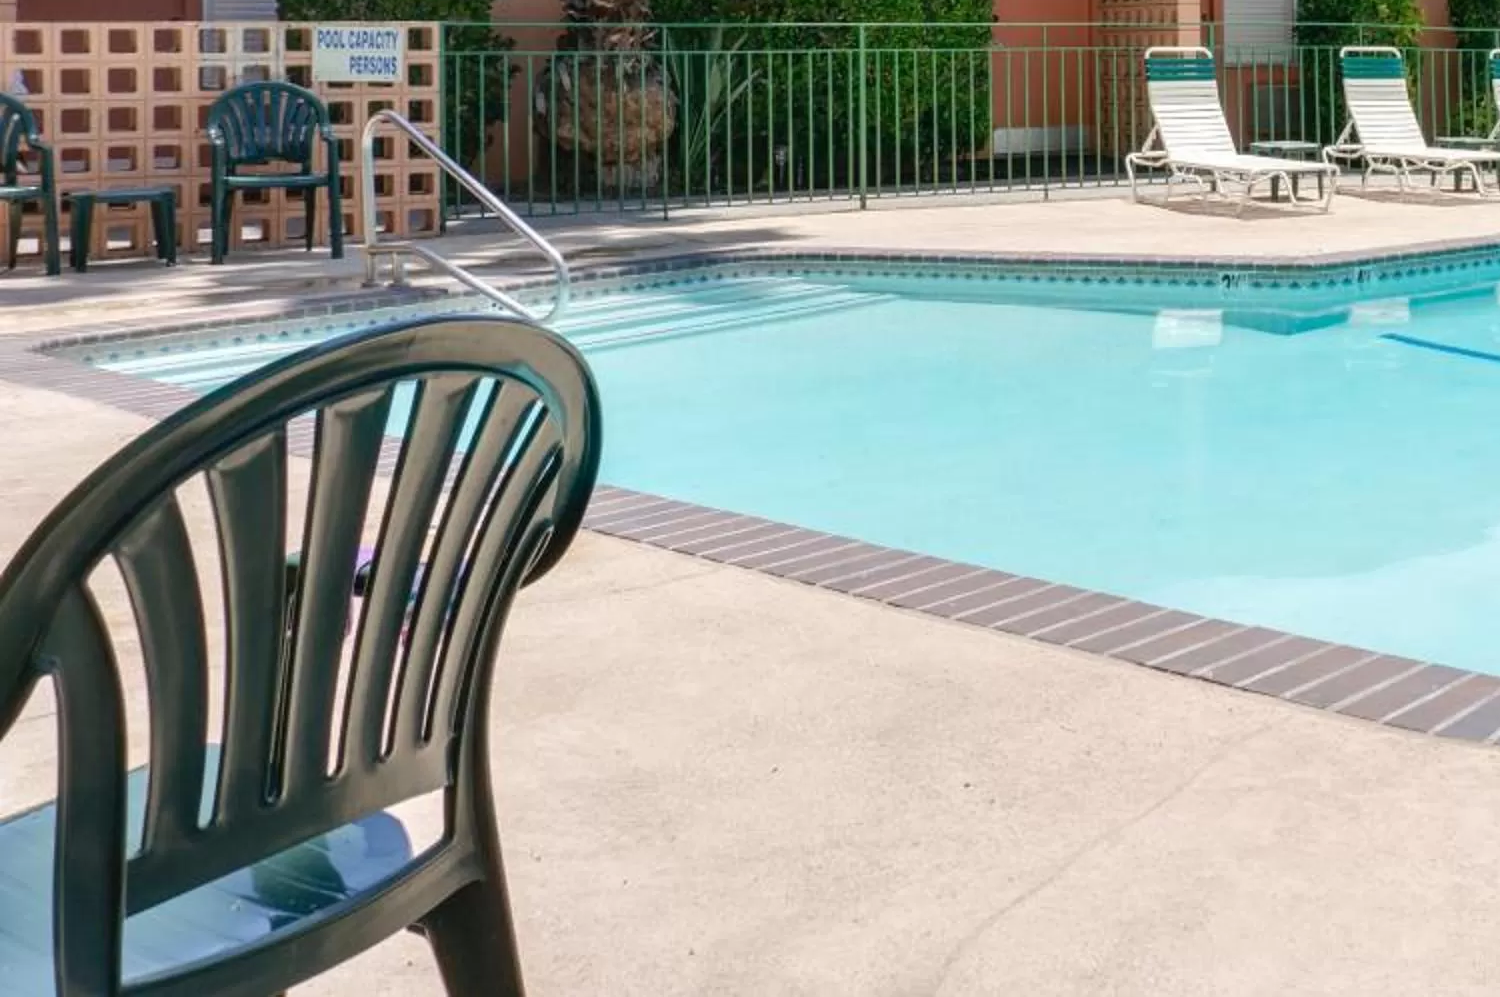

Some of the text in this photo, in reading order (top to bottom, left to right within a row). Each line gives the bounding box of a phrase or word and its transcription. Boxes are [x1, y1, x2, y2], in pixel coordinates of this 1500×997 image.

[318, 30, 398, 50] POOL CAPACITY
[349, 55, 397, 75] PERSONS
